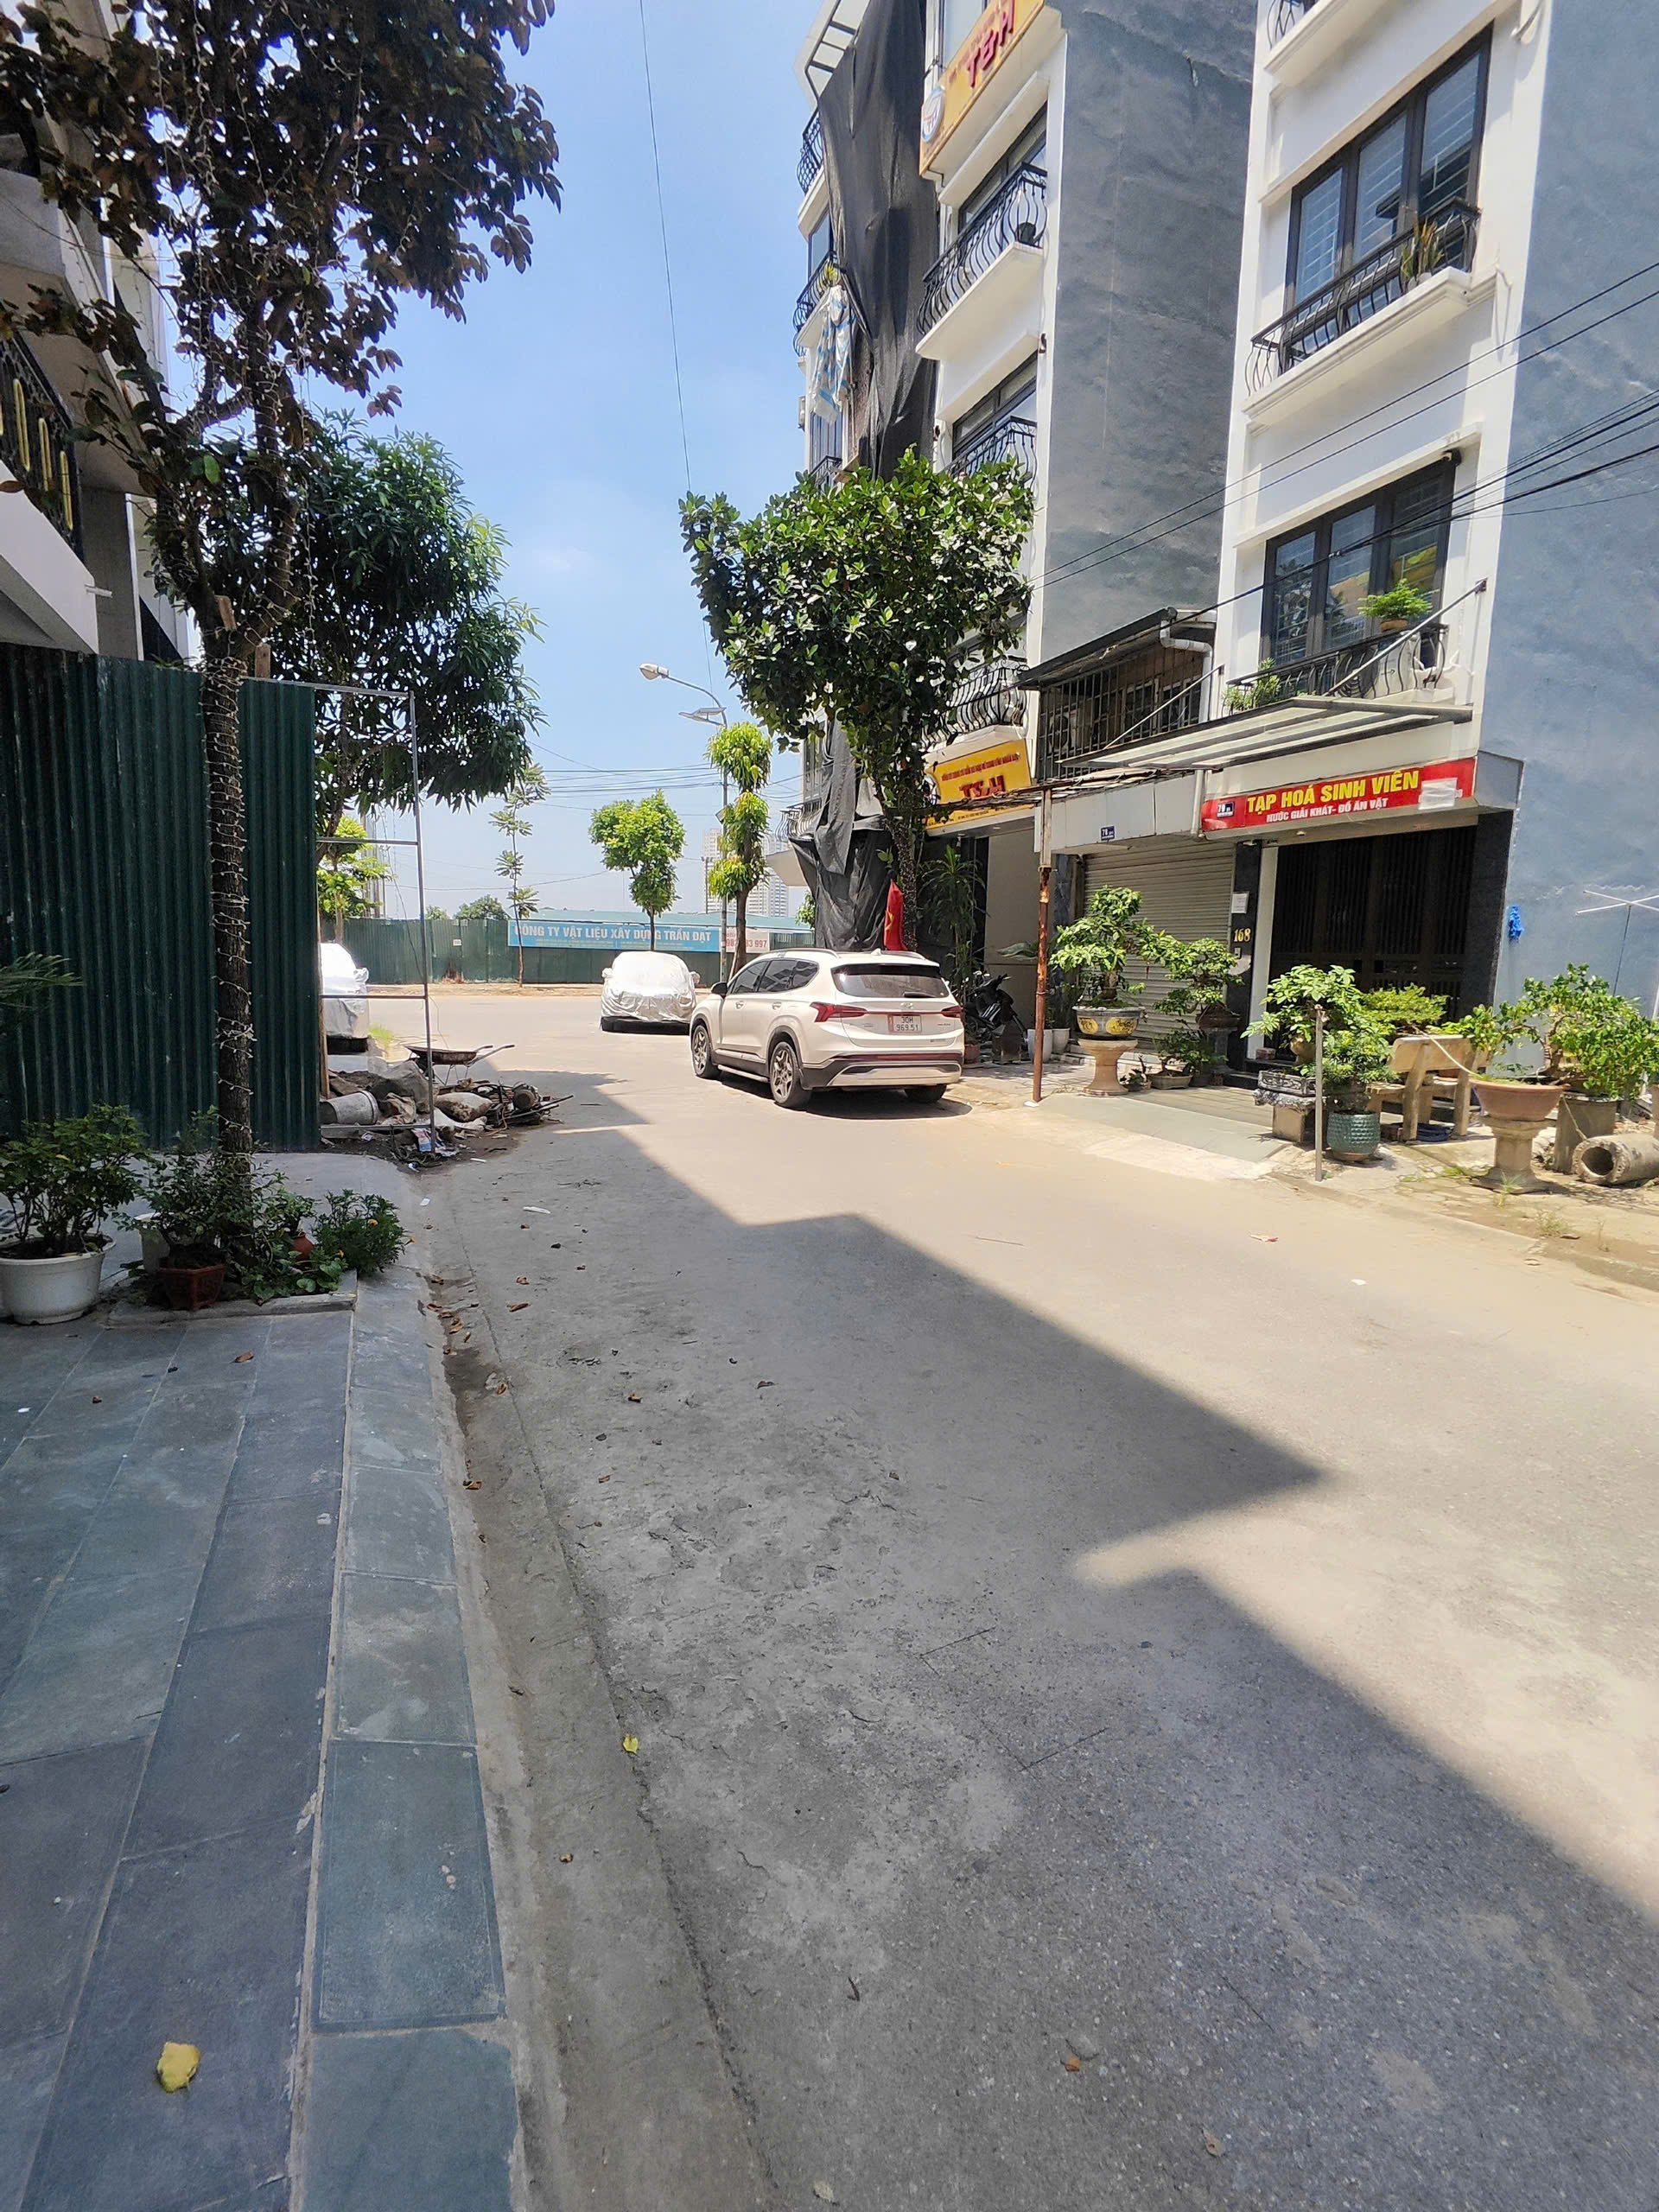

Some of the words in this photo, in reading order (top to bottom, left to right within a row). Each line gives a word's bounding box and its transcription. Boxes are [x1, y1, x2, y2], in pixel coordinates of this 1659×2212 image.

[1247, 794, 1276, 815] TẠP
[1281, 785, 1315, 808] HOÁ
[1320, 779, 1367, 803] SINH
[1371, 770, 1420, 795] VIÊN
[548, 926, 560, 937] TY
[563, 925, 582, 939] VẬT
[585, 927, 607, 940] LIỆU
[611, 927, 631, 939] XÂY
[1234, 928, 1251, 942] 168
